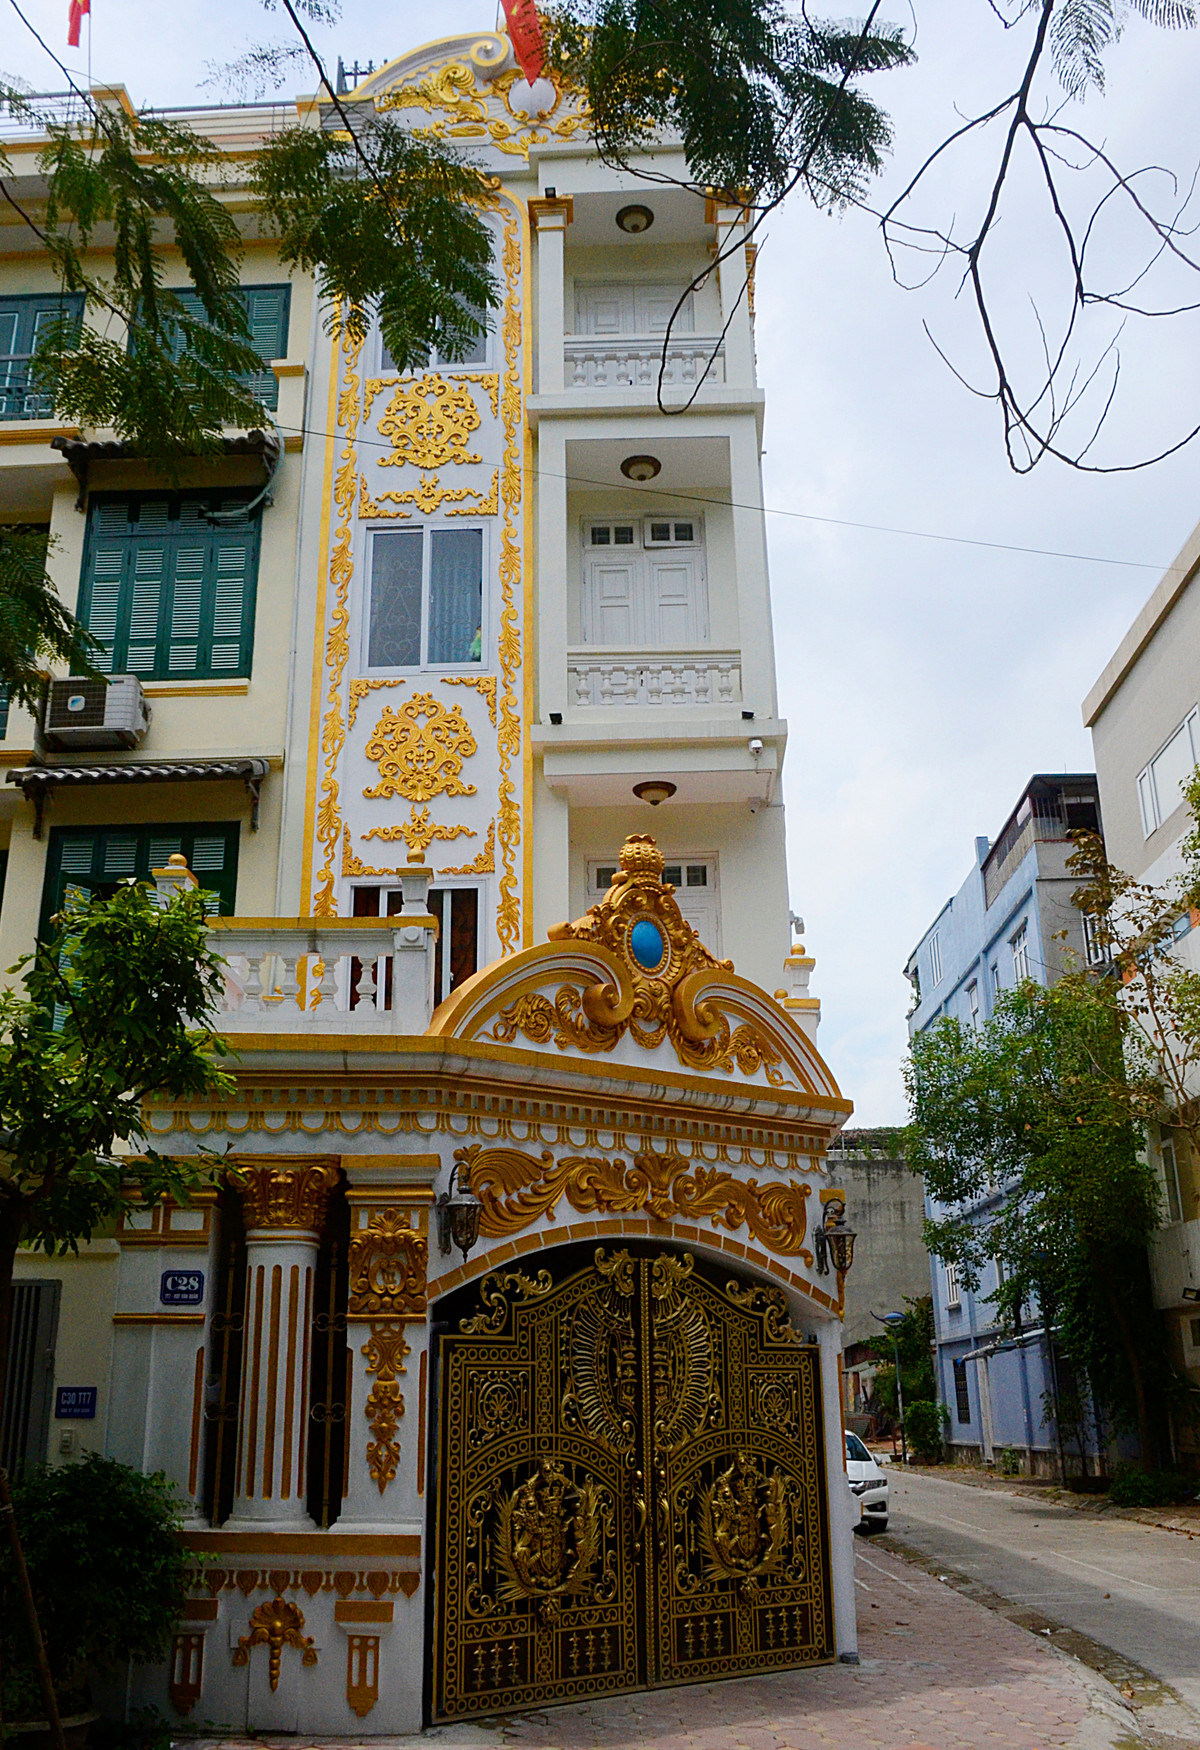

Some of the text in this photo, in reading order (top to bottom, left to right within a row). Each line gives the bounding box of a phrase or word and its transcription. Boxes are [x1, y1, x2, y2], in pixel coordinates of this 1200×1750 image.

[166, 1276, 199, 1291] C28
[61, 1391, 92, 1405] C30 TT7
